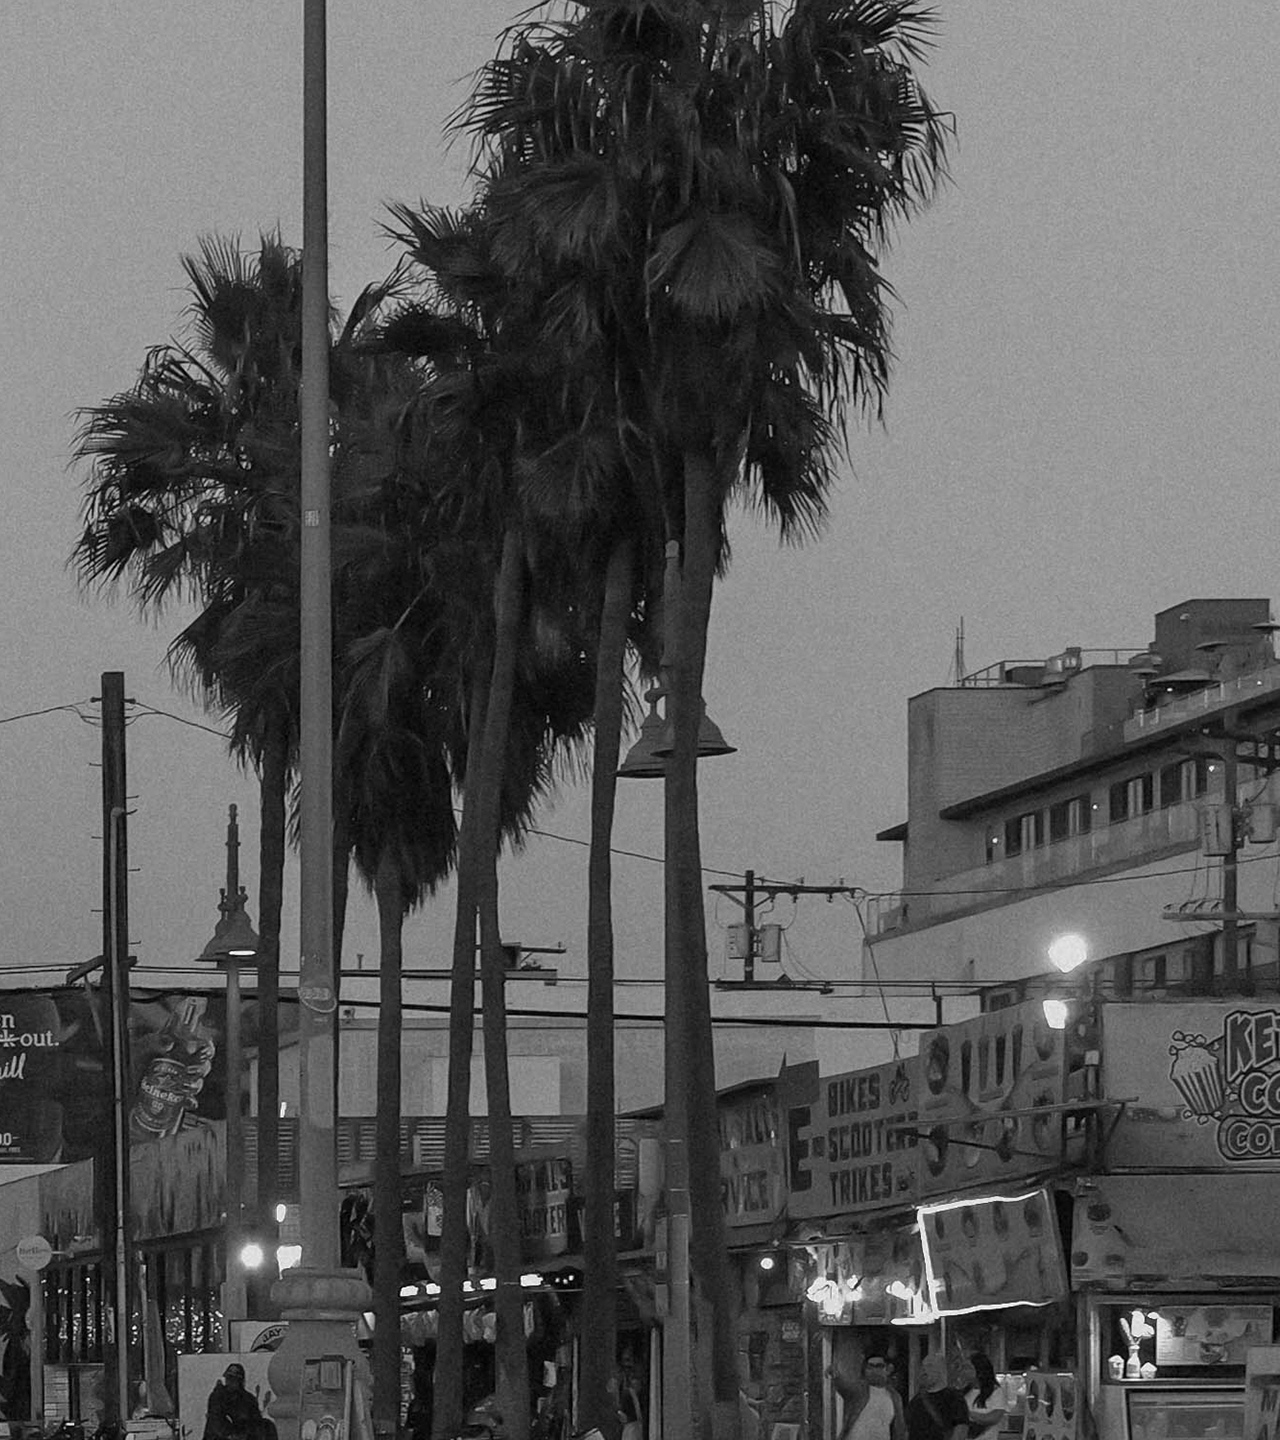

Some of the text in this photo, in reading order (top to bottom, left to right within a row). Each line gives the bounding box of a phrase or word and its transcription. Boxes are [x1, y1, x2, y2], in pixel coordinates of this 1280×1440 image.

[19, 1029, 60, 1047] out.
[1226, 1013, 1280, 1083] KE
[827, 1073, 880, 1117] BIKES
[827, 1111, 919, 1162] SCOOTERS
[828, 1162, 893, 1207] TRIKES
